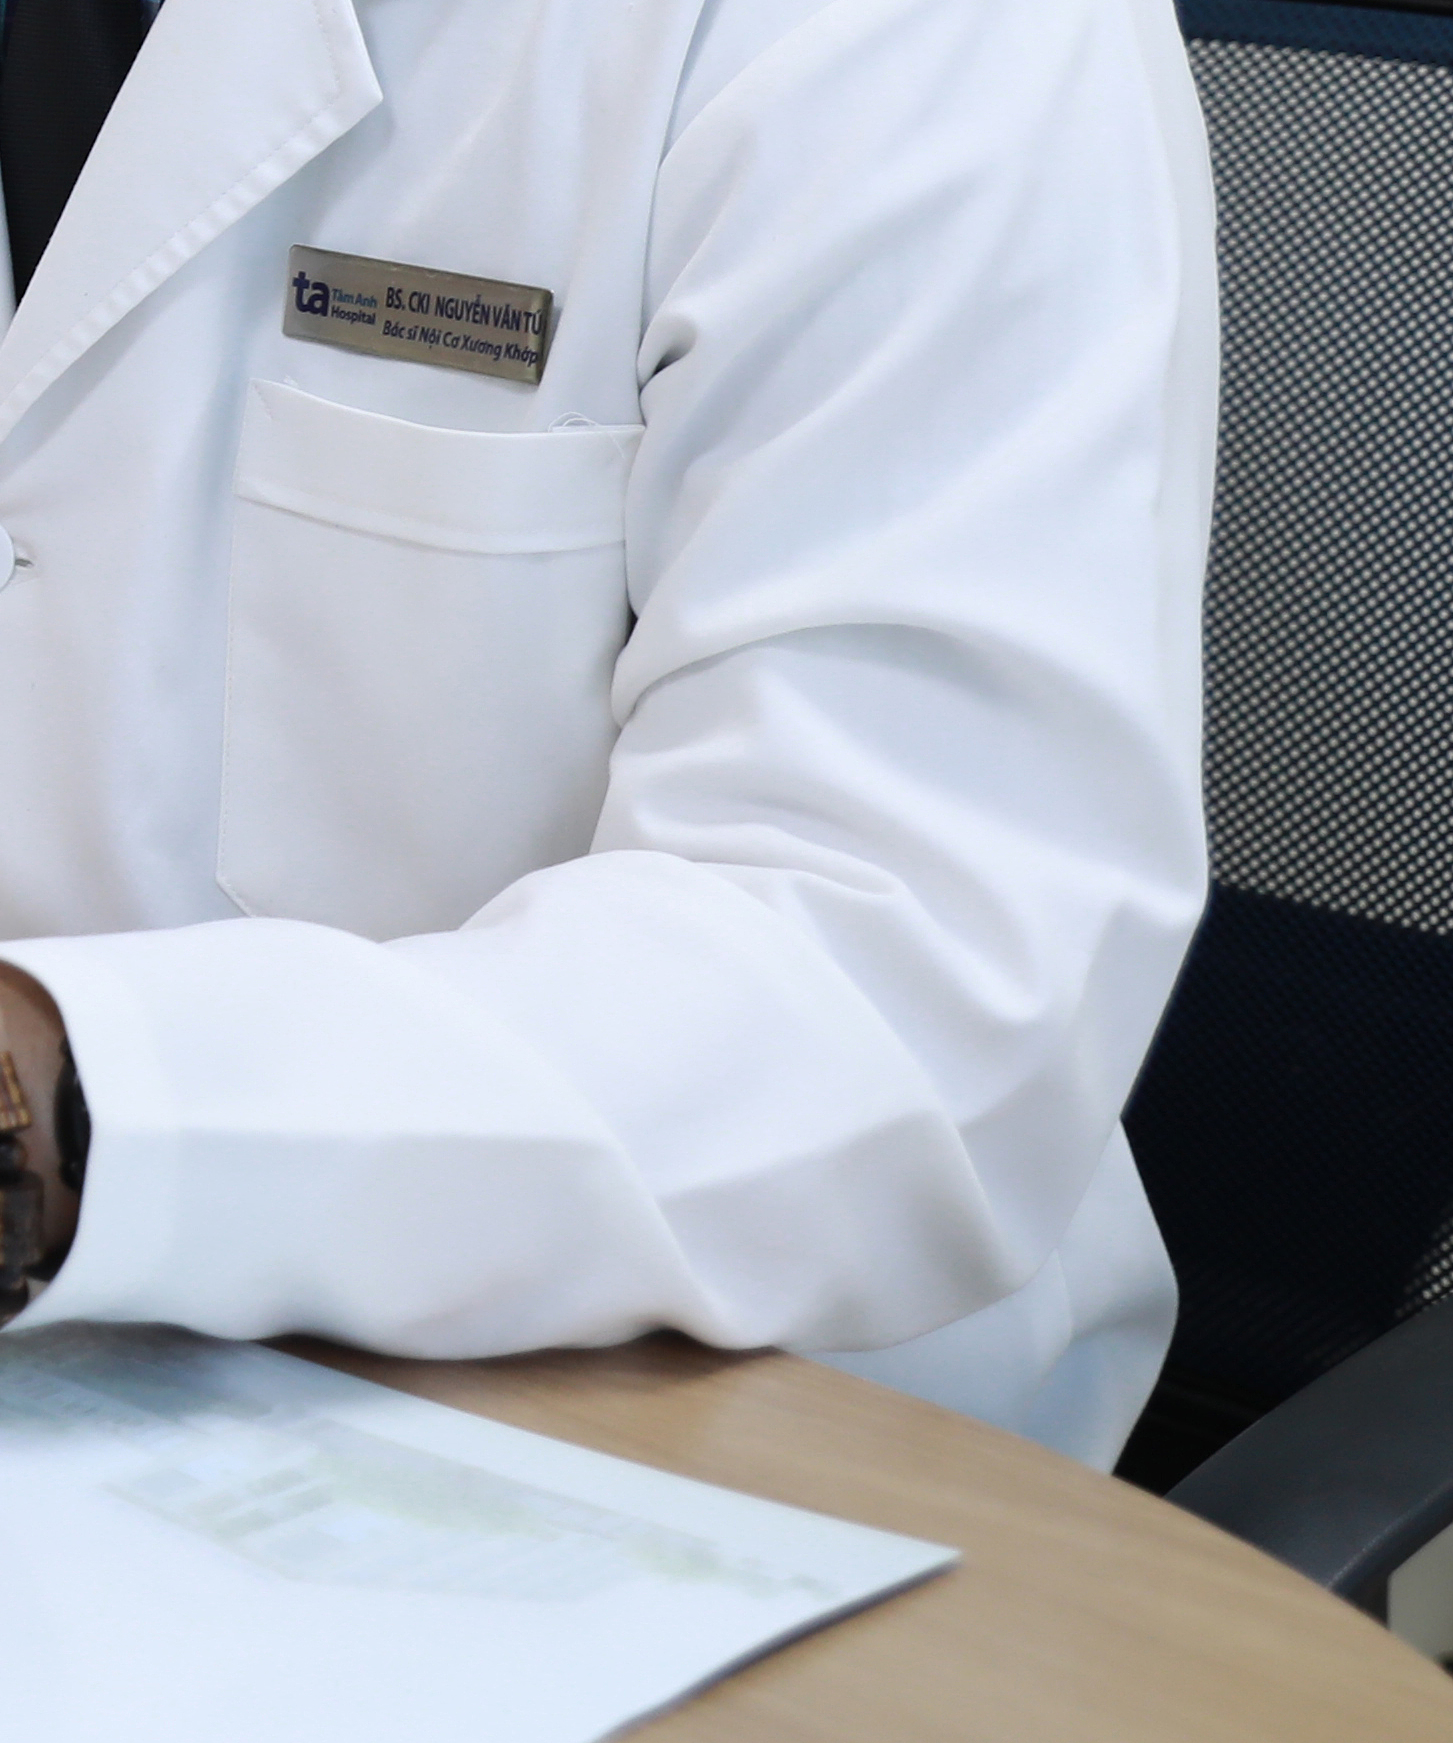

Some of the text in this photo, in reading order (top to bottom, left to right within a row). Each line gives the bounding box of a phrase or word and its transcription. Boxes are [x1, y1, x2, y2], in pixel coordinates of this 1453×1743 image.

[331, 306, 376, 326] Hospital
[386, 287, 405, 310] BS.
[409, 291, 430, 314] CKI
[435, 293, 491, 325] NGUYỄN
[493, 307, 521, 330] VĂN
[382, 320, 405, 339] Bác
[419, 326, 441, 350] Nội
[459, 336, 502, 361] Xương
[503, 341, 539, 366] Khớp
